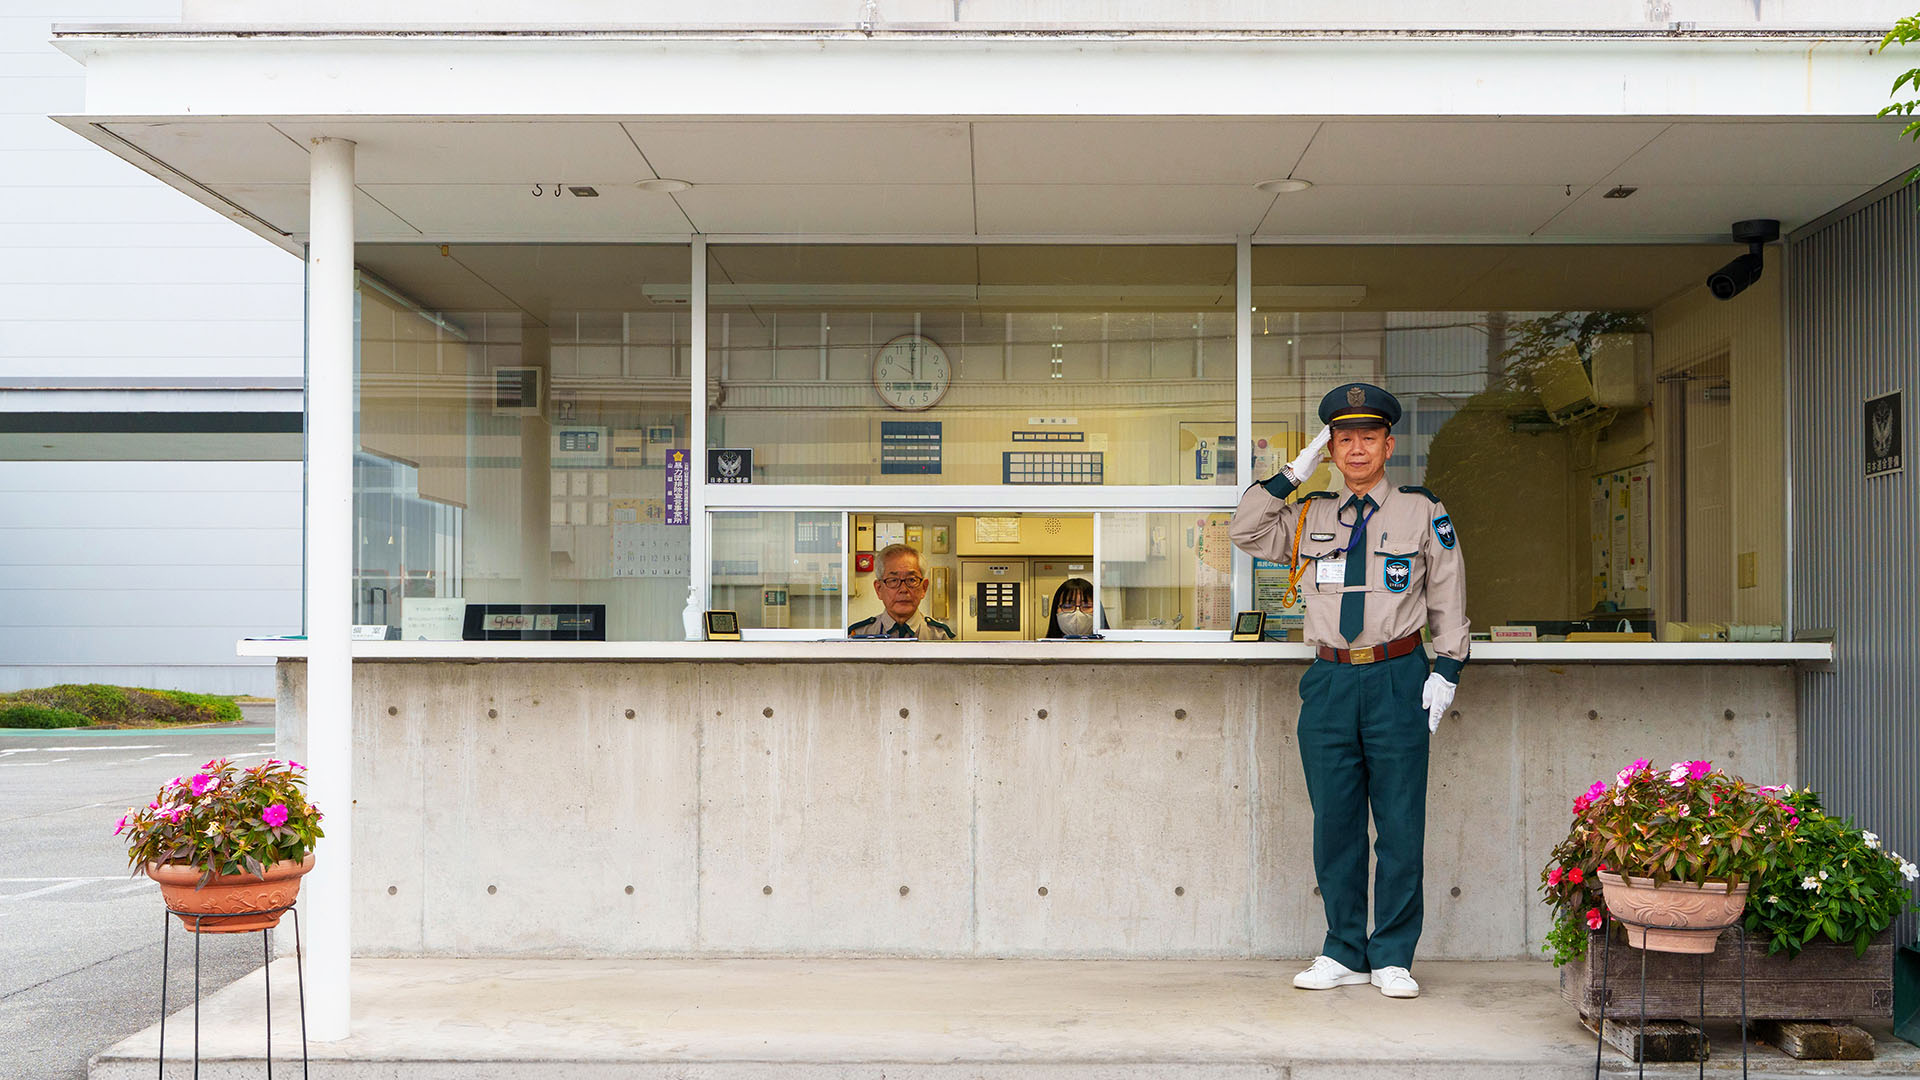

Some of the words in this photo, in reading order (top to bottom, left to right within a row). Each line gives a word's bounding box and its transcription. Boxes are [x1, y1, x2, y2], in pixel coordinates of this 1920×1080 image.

[896, 345, 903, 355] 11
[909, 343, 917, 352] 12
[924, 345, 928, 355] 1
[885, 355, 893, 365] 10
[933, 355, 940, 365] 2
[881, 368, 887, 378] 9
[937, 369, 944, 379] 3
[885, 382, 892, 391] 8
[933, 382, 940, 392] 4
[896, 392, 902, 402] 7
[909, 395, 916, 405] 6
[922, 392, 929, 402] 5
